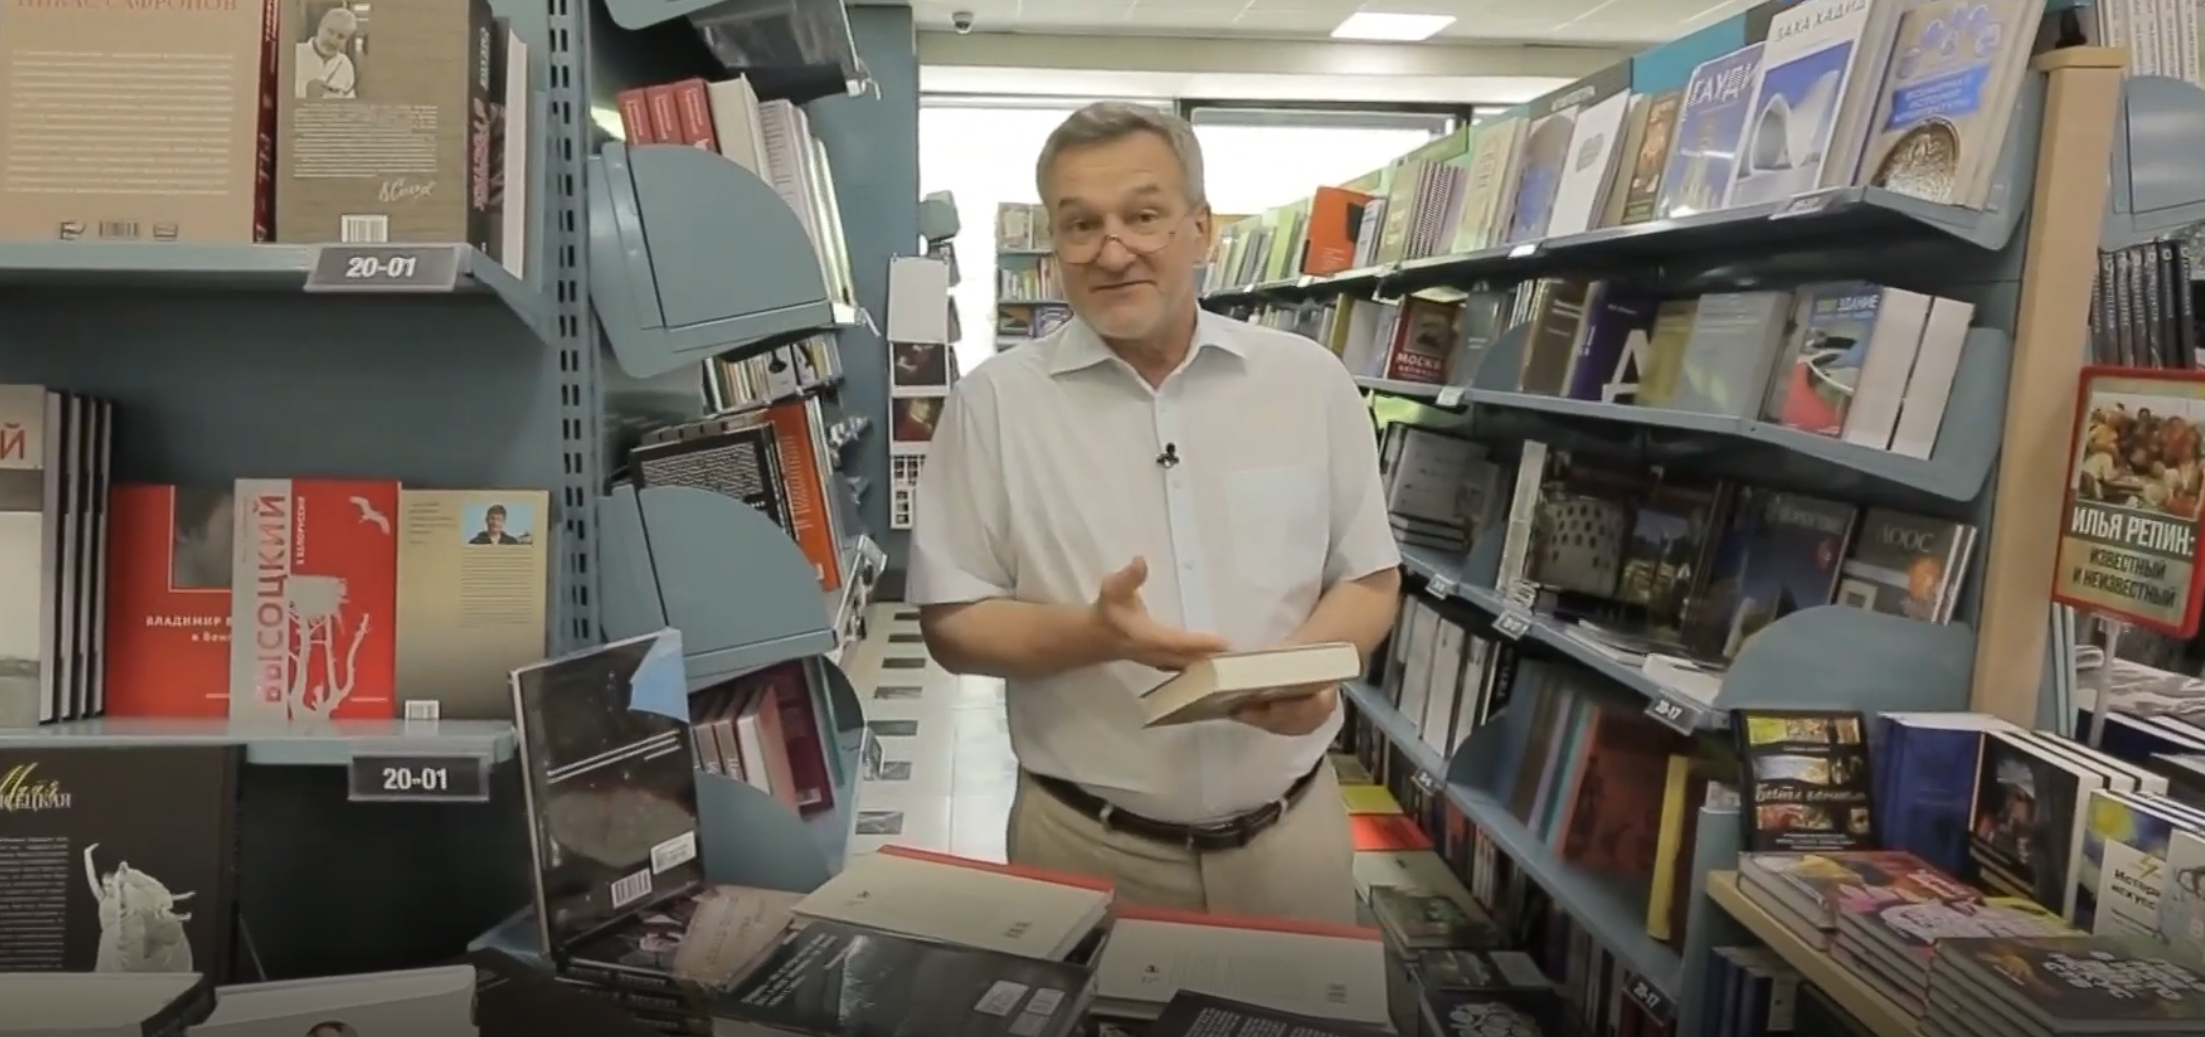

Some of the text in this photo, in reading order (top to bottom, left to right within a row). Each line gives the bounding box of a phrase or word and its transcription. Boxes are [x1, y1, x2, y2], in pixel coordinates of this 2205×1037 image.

[346, 256, 417, 279] 20-01
[2070, 506, 2196, 557] ИЛЬЯ РЕПИН:
[2090, 546, 2167, 580] ИЗВЕСТНЫЙ
[252, 494, 288, 703] ВЫСОЦКИЙ
[2083, 568, 2177, 609] НЕИЗВЕСТНЫЙ
[145, 615, 222, 628] ВЛАДИМИР
[382, 767, 448, 790] 20-01
